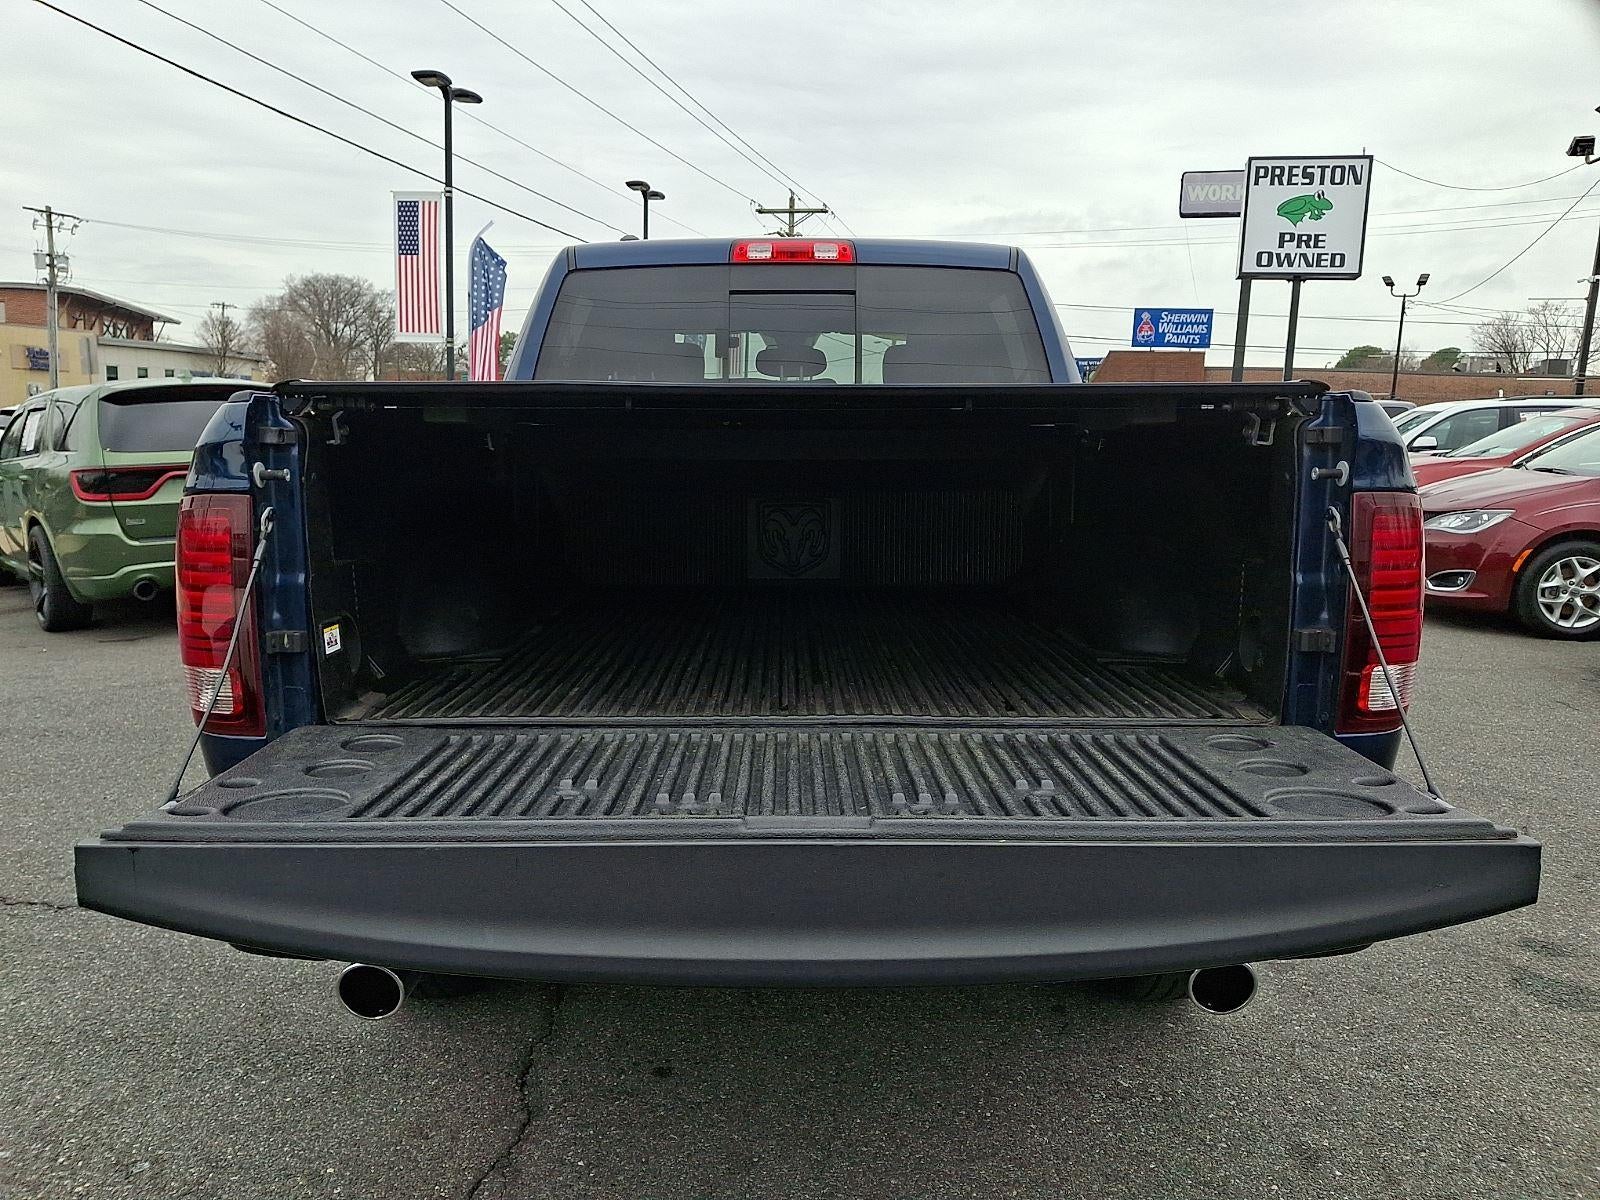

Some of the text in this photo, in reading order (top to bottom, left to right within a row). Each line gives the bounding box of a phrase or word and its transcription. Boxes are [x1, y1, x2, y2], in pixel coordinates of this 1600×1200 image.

[1254, 165, 1363, 186] PRESTON
[1278, 232, 1326, 249] PRE
[1256, 251, 1345, 268] OWNED
[1160, 311, 1208, 323] SHERWIN
[1158, 323, 1208, 334] WILLIAMS
[1164, 333, 1200, 344] PAINTS
